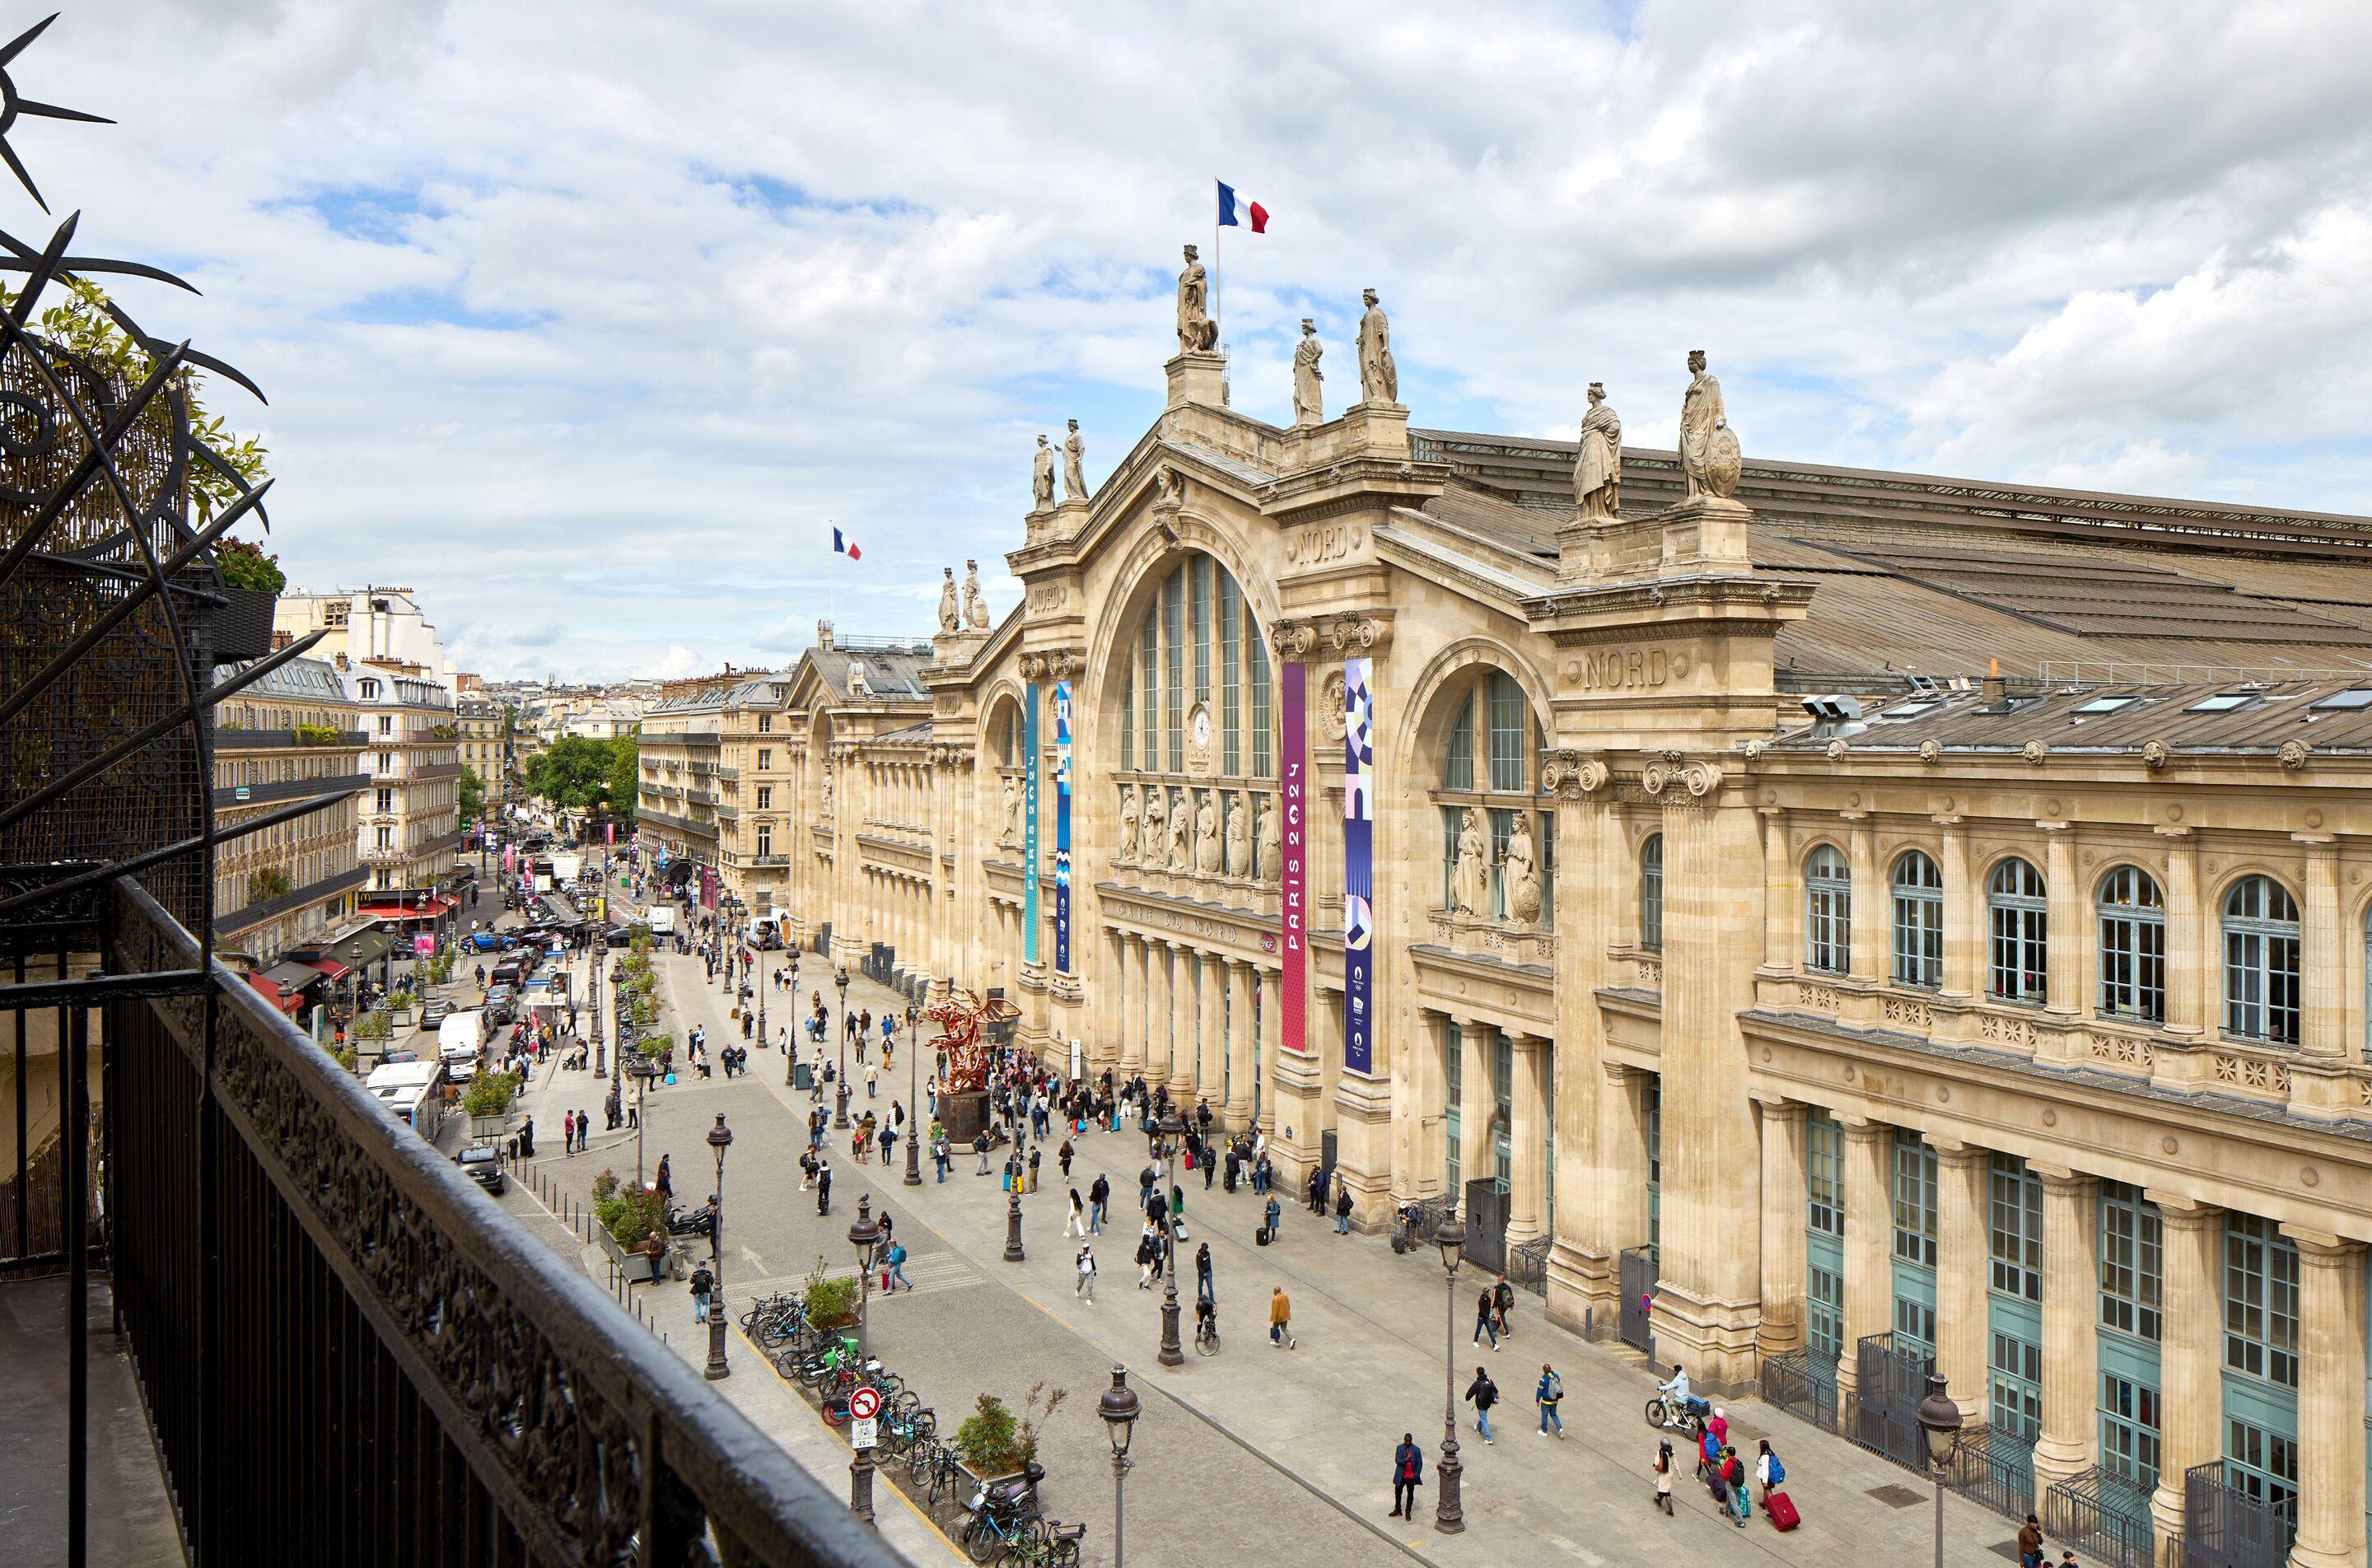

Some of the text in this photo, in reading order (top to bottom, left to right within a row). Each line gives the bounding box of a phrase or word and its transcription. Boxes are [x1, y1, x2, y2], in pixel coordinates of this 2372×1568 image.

[1298, 525, 1347, 564] NORD
[1034, 586, 1059, 614] NORD
[1584, 648, 1667, 689] NORD
[1288, 763, 1300, 950] PARIS 2024
[1118, 903, 1237, 942] GARE DU NORD
